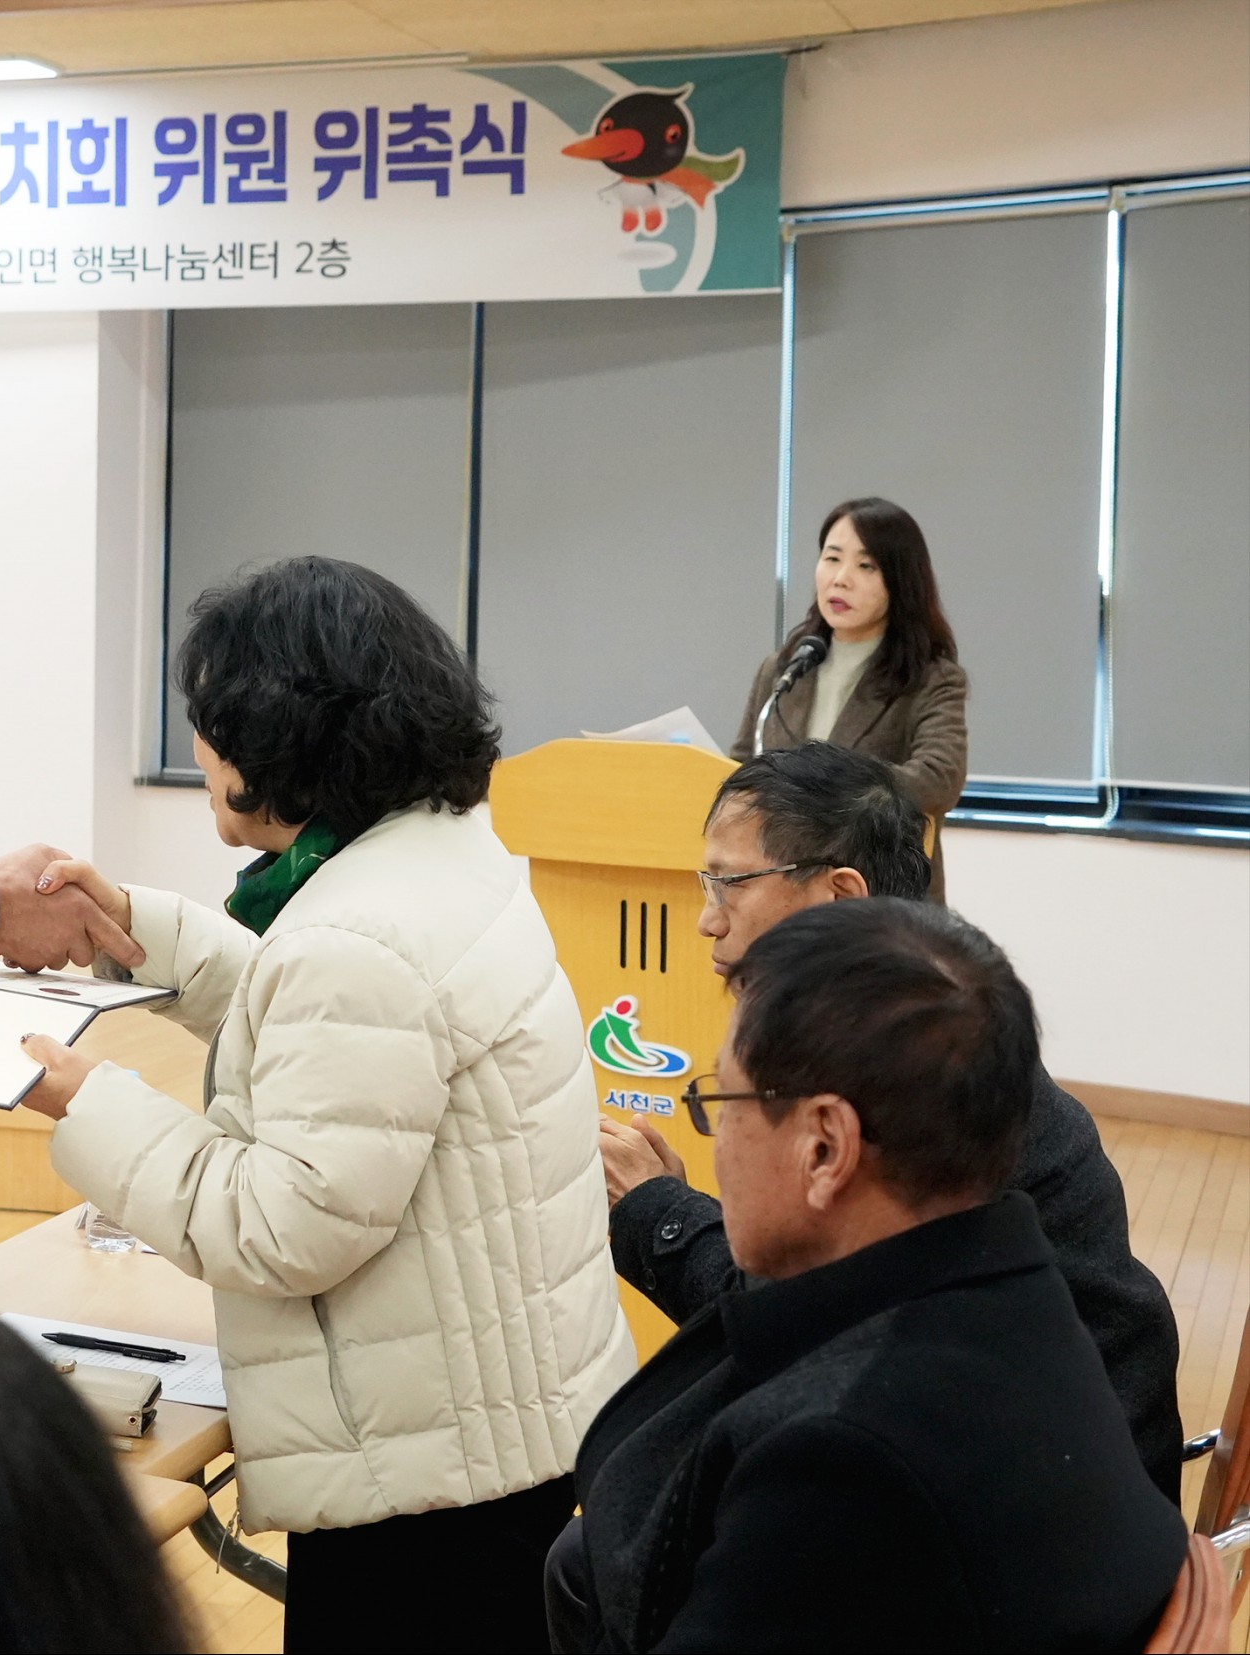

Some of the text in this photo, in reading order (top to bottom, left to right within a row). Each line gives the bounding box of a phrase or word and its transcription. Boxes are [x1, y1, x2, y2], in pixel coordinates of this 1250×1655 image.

[153, 110, 288, 206] 위원
[313, 100, 527, 202] 위촉식
[73, 239, 279, 284] 행복나눔센터
[294, 236, 352, 280] 2층
[605, 1091, 673, 1115] 서천군
